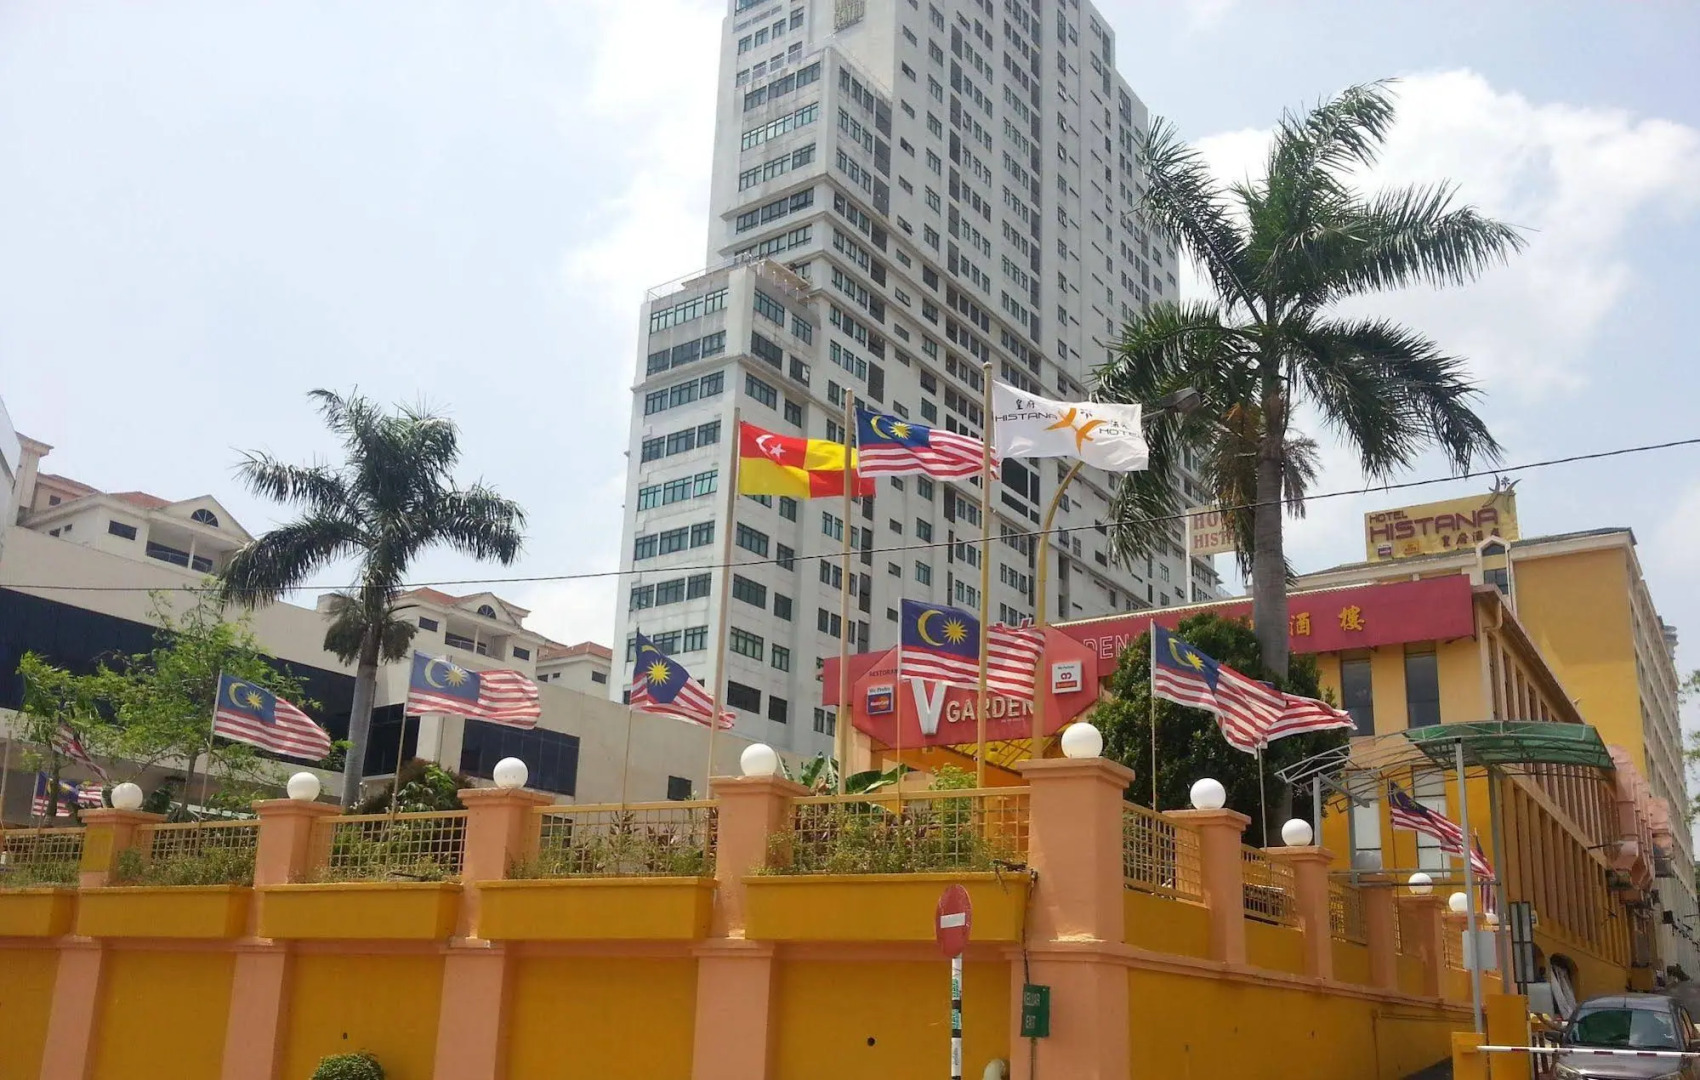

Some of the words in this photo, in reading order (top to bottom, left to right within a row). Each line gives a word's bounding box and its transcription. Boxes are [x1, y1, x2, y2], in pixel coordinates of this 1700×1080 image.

[995, 411, 1058, 422] HISTANA
[1369, 510, 1409, 524] HOTEL
[1369, 507, 1499, 543] HISTANA
[909, 678, 948, 736] V
